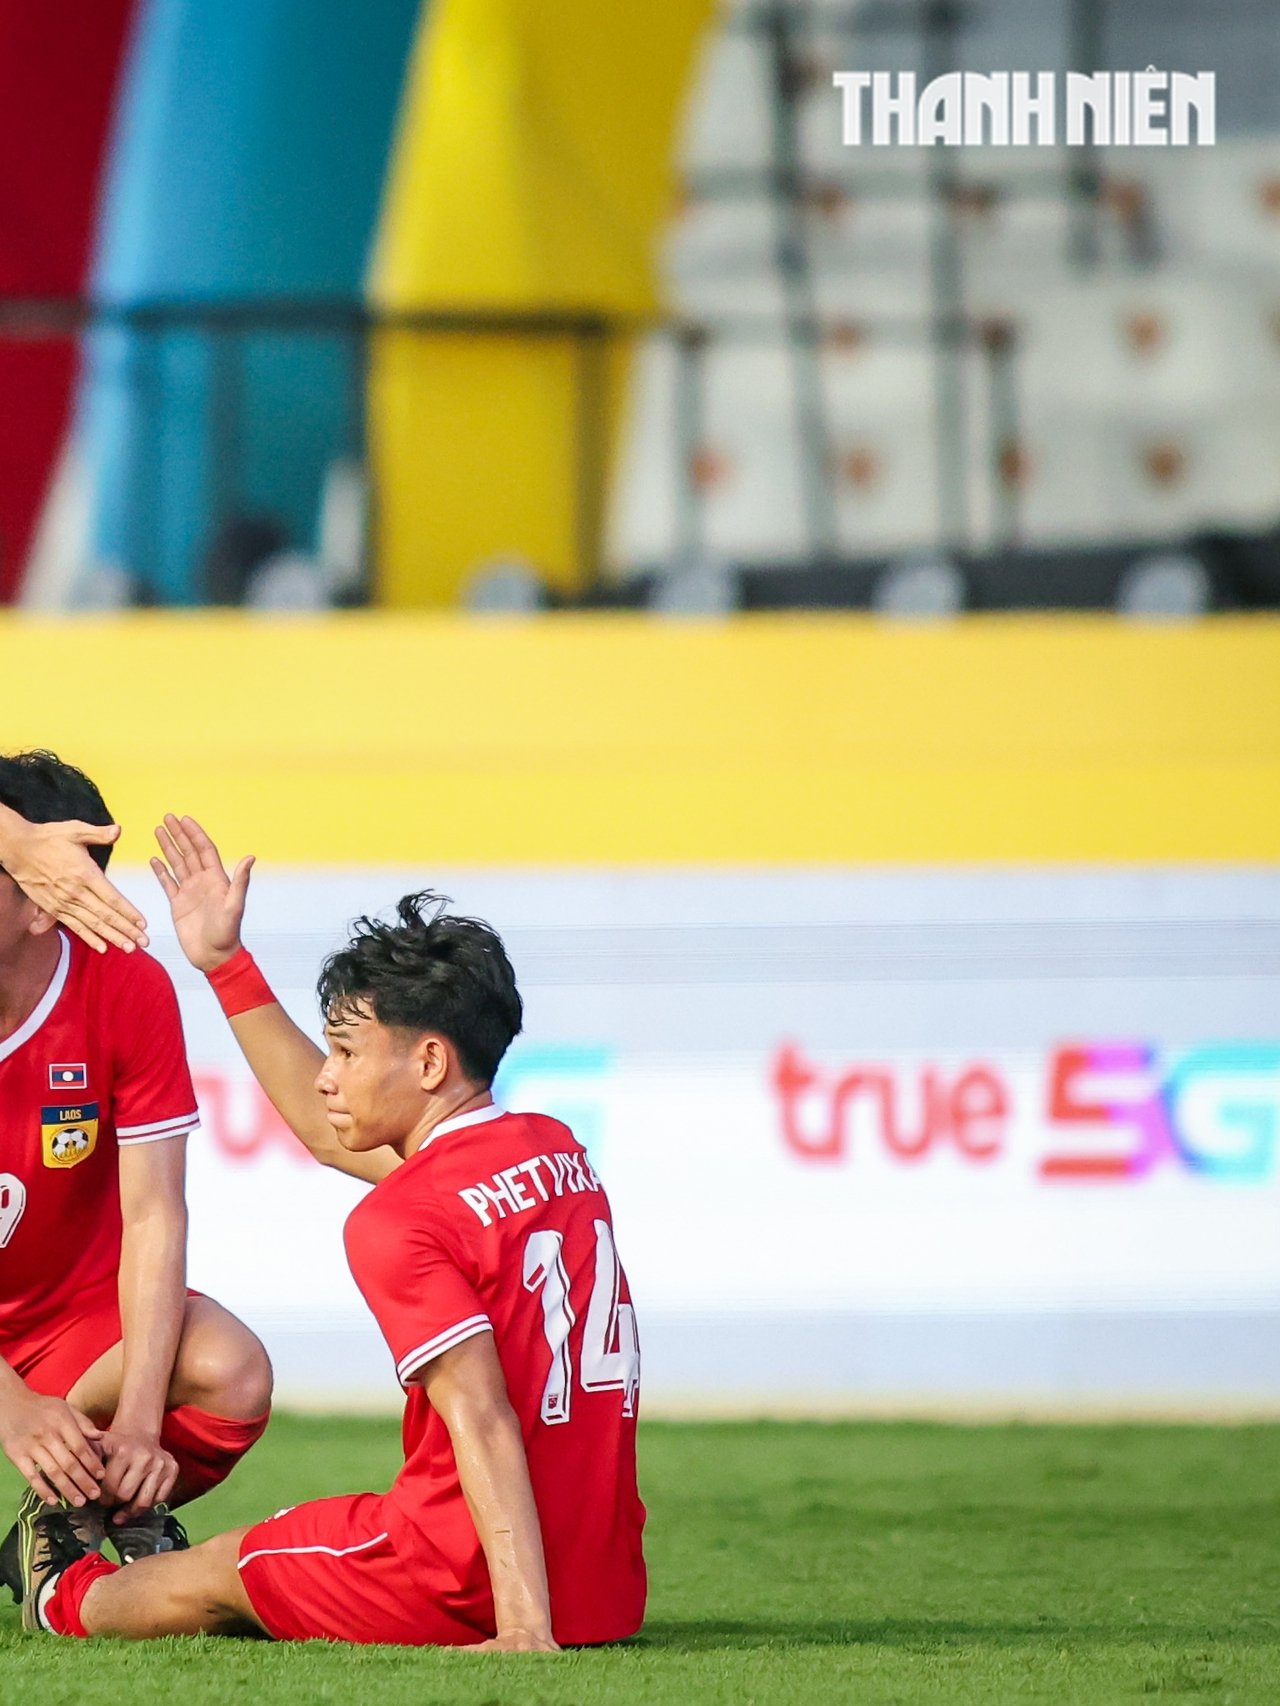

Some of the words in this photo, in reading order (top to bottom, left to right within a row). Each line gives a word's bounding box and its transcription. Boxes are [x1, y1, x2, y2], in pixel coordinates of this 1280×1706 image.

[59, 1109, 82, 1121] LAOS
[774, 1039, 1009, 1161] true
[1038, 1040, 1280, 1183] 5G
[523, 1219, 640, 1426] 14
